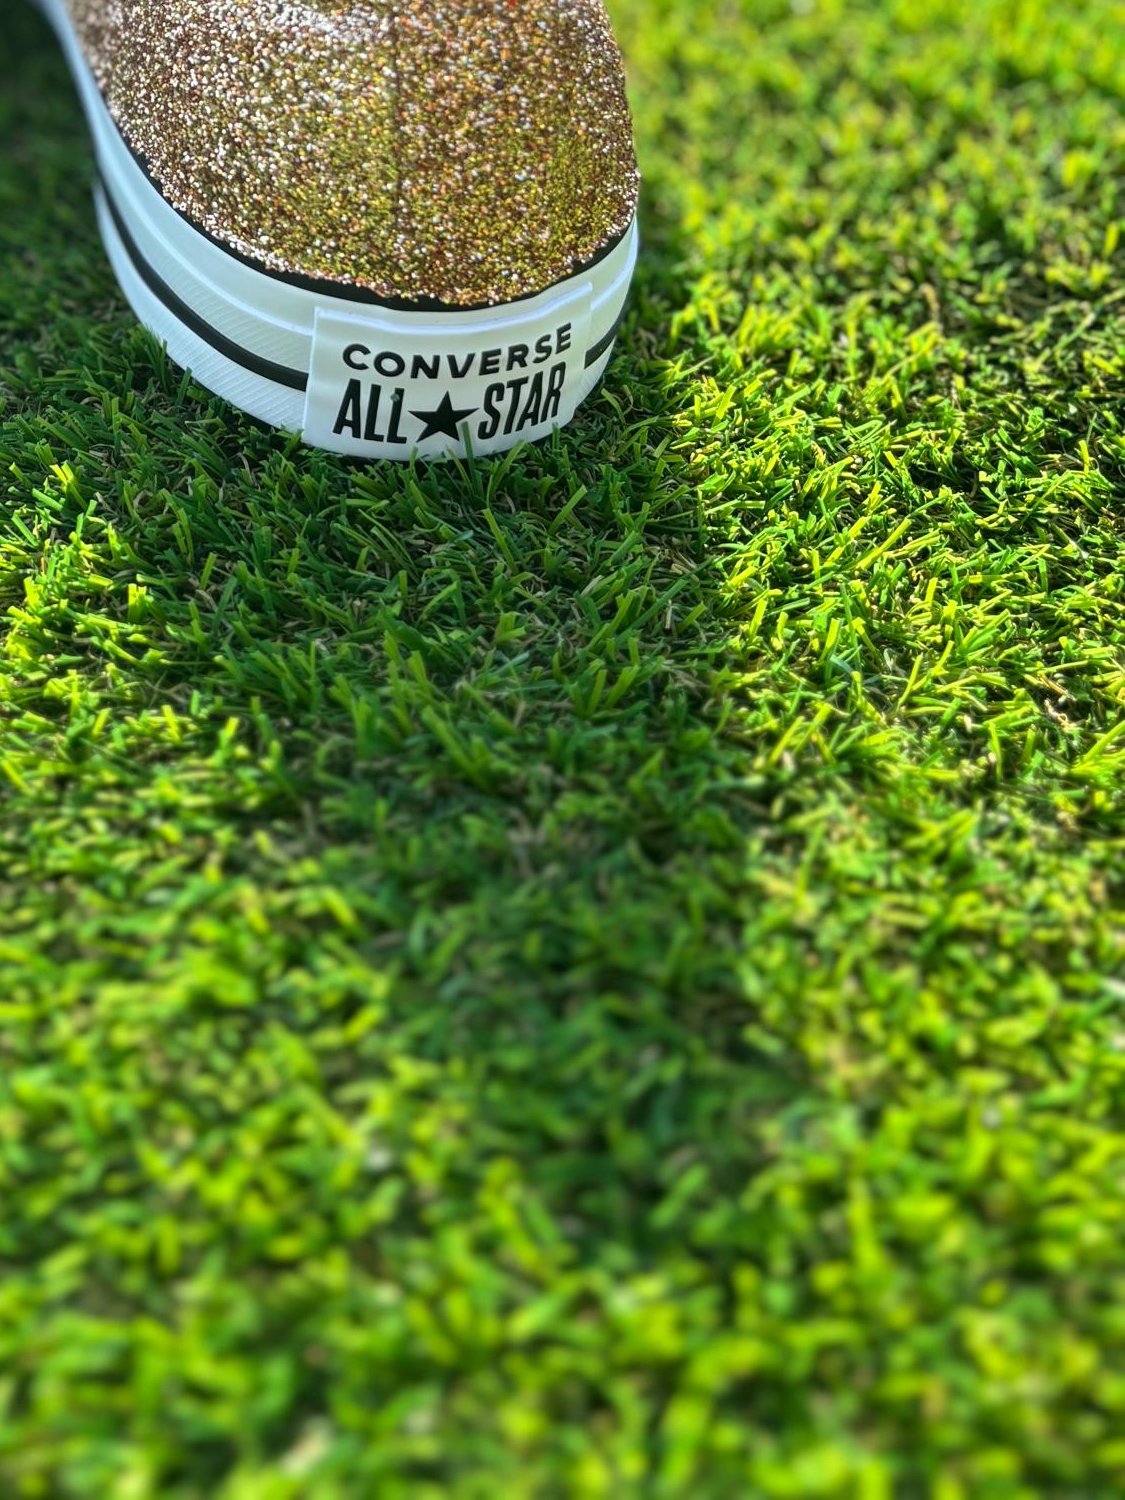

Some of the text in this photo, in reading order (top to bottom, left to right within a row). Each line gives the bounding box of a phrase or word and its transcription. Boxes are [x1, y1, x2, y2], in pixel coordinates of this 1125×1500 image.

[342, 322, 572, 379] CONVERSE
[332, 362, 566, 444] ALL STAR
